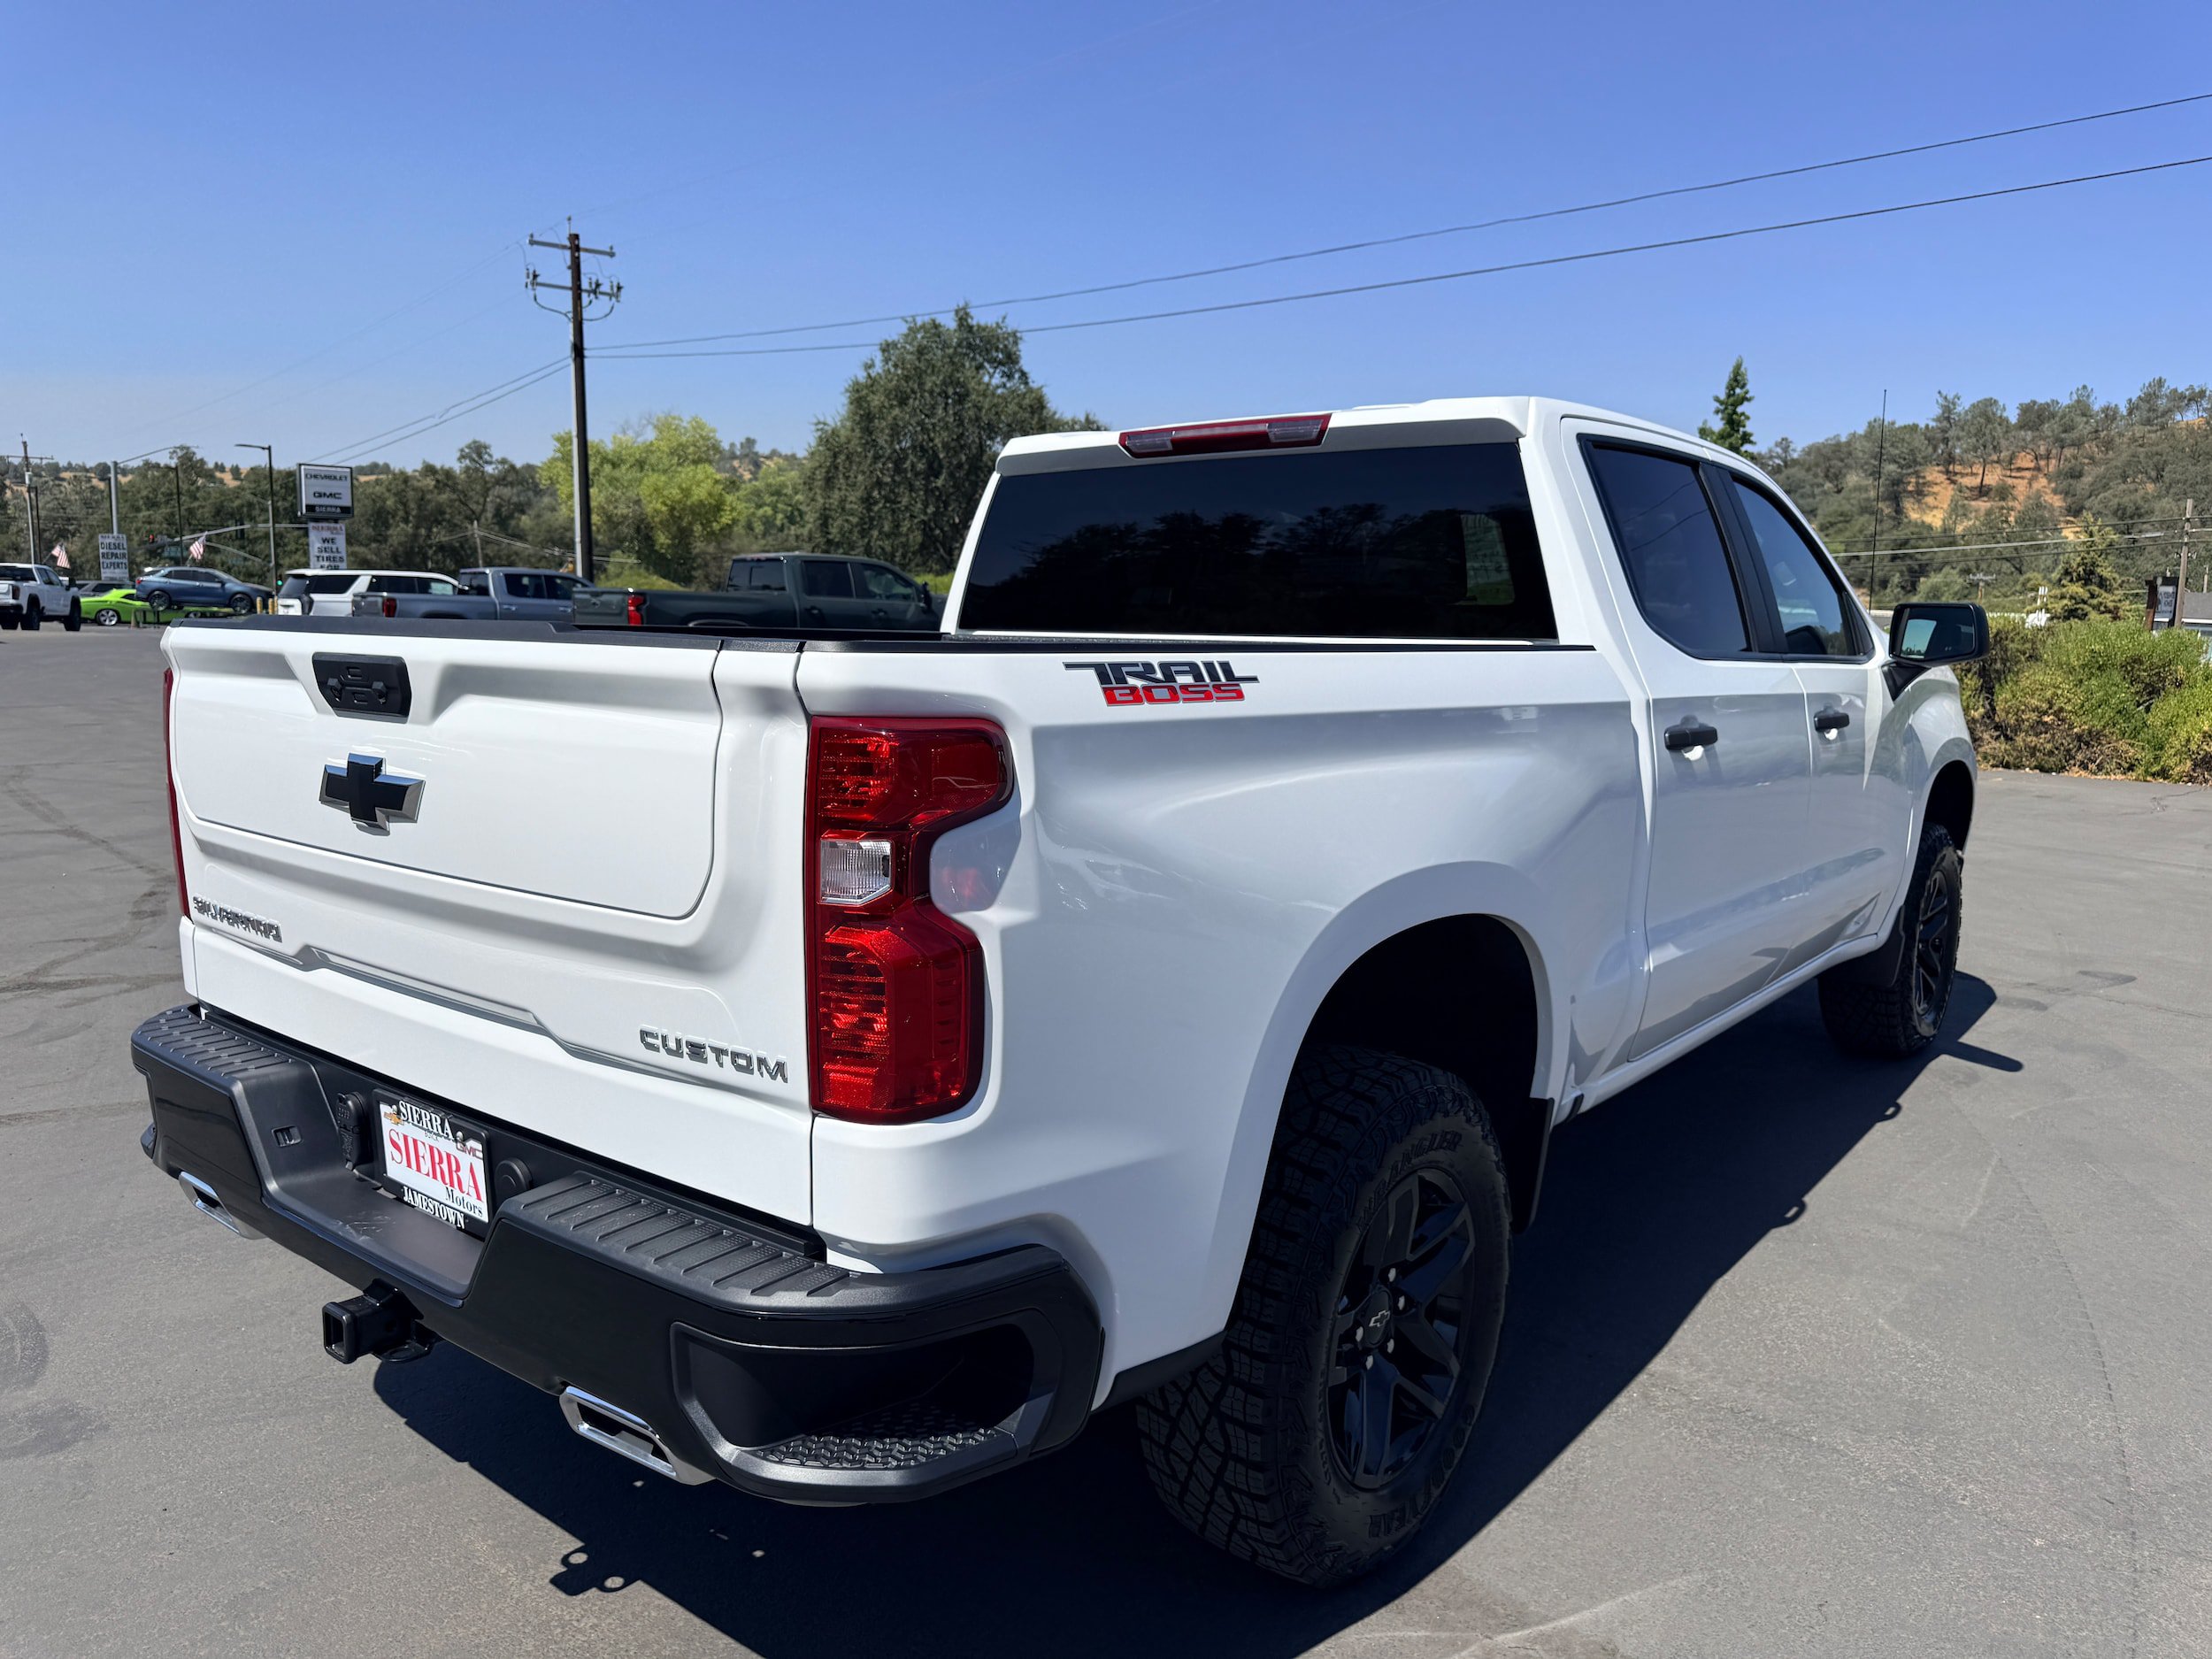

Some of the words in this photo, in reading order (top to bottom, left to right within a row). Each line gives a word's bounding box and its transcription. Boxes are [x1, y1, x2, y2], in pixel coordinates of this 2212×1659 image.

[305, 472, 348, 481] CHEVROLET
[101, 541, 127, 550] DIESEL
[321, 536, 336, 545] WE
[101, 551, 127, 560] REPAIR
[102, 561, 128, 570] EXPERTS
[1062, 660, 1260, 685] TRAIL
[1101, 682, 1246, 706] BOSS
[639, 1024, 788, 1084] CUSTOM
[398, 1100, 455, 1141] SIERRA
[456, 1141, 483, 1160] GMC
[388, 1128, 485, 1203] SIERRA
[403, 1186, 466, 1229] JAMESTOWN
[444, 1187, 484, 1217] Motors
